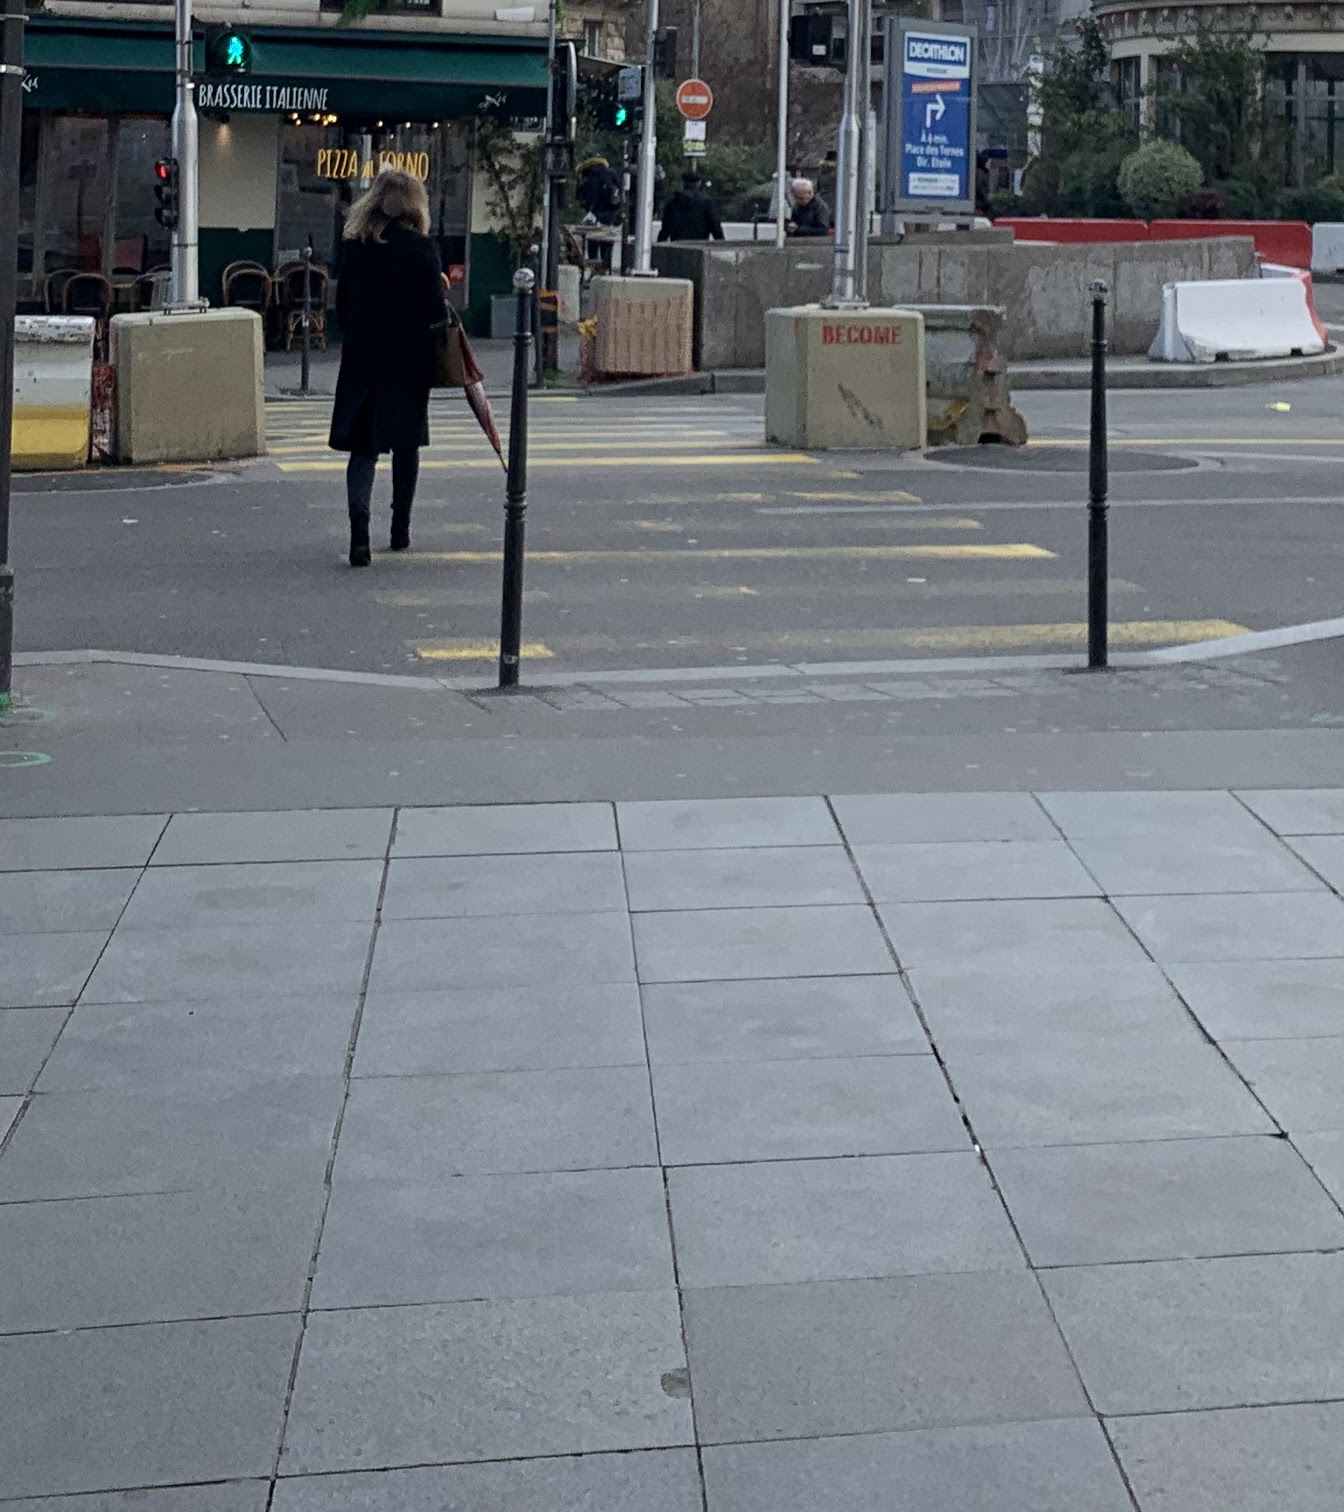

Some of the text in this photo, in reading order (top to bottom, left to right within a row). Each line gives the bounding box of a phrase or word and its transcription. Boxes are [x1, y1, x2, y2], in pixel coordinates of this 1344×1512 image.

[909, 41, 965, 62] DECATHLON
[199, 84, 328, 110] BRASSERIE ITALIENNE
[317, 148, 358, 179] PIZZA
[379, 151, 429, 182] FORNO
[822, 324, 902, 345] BECOME
